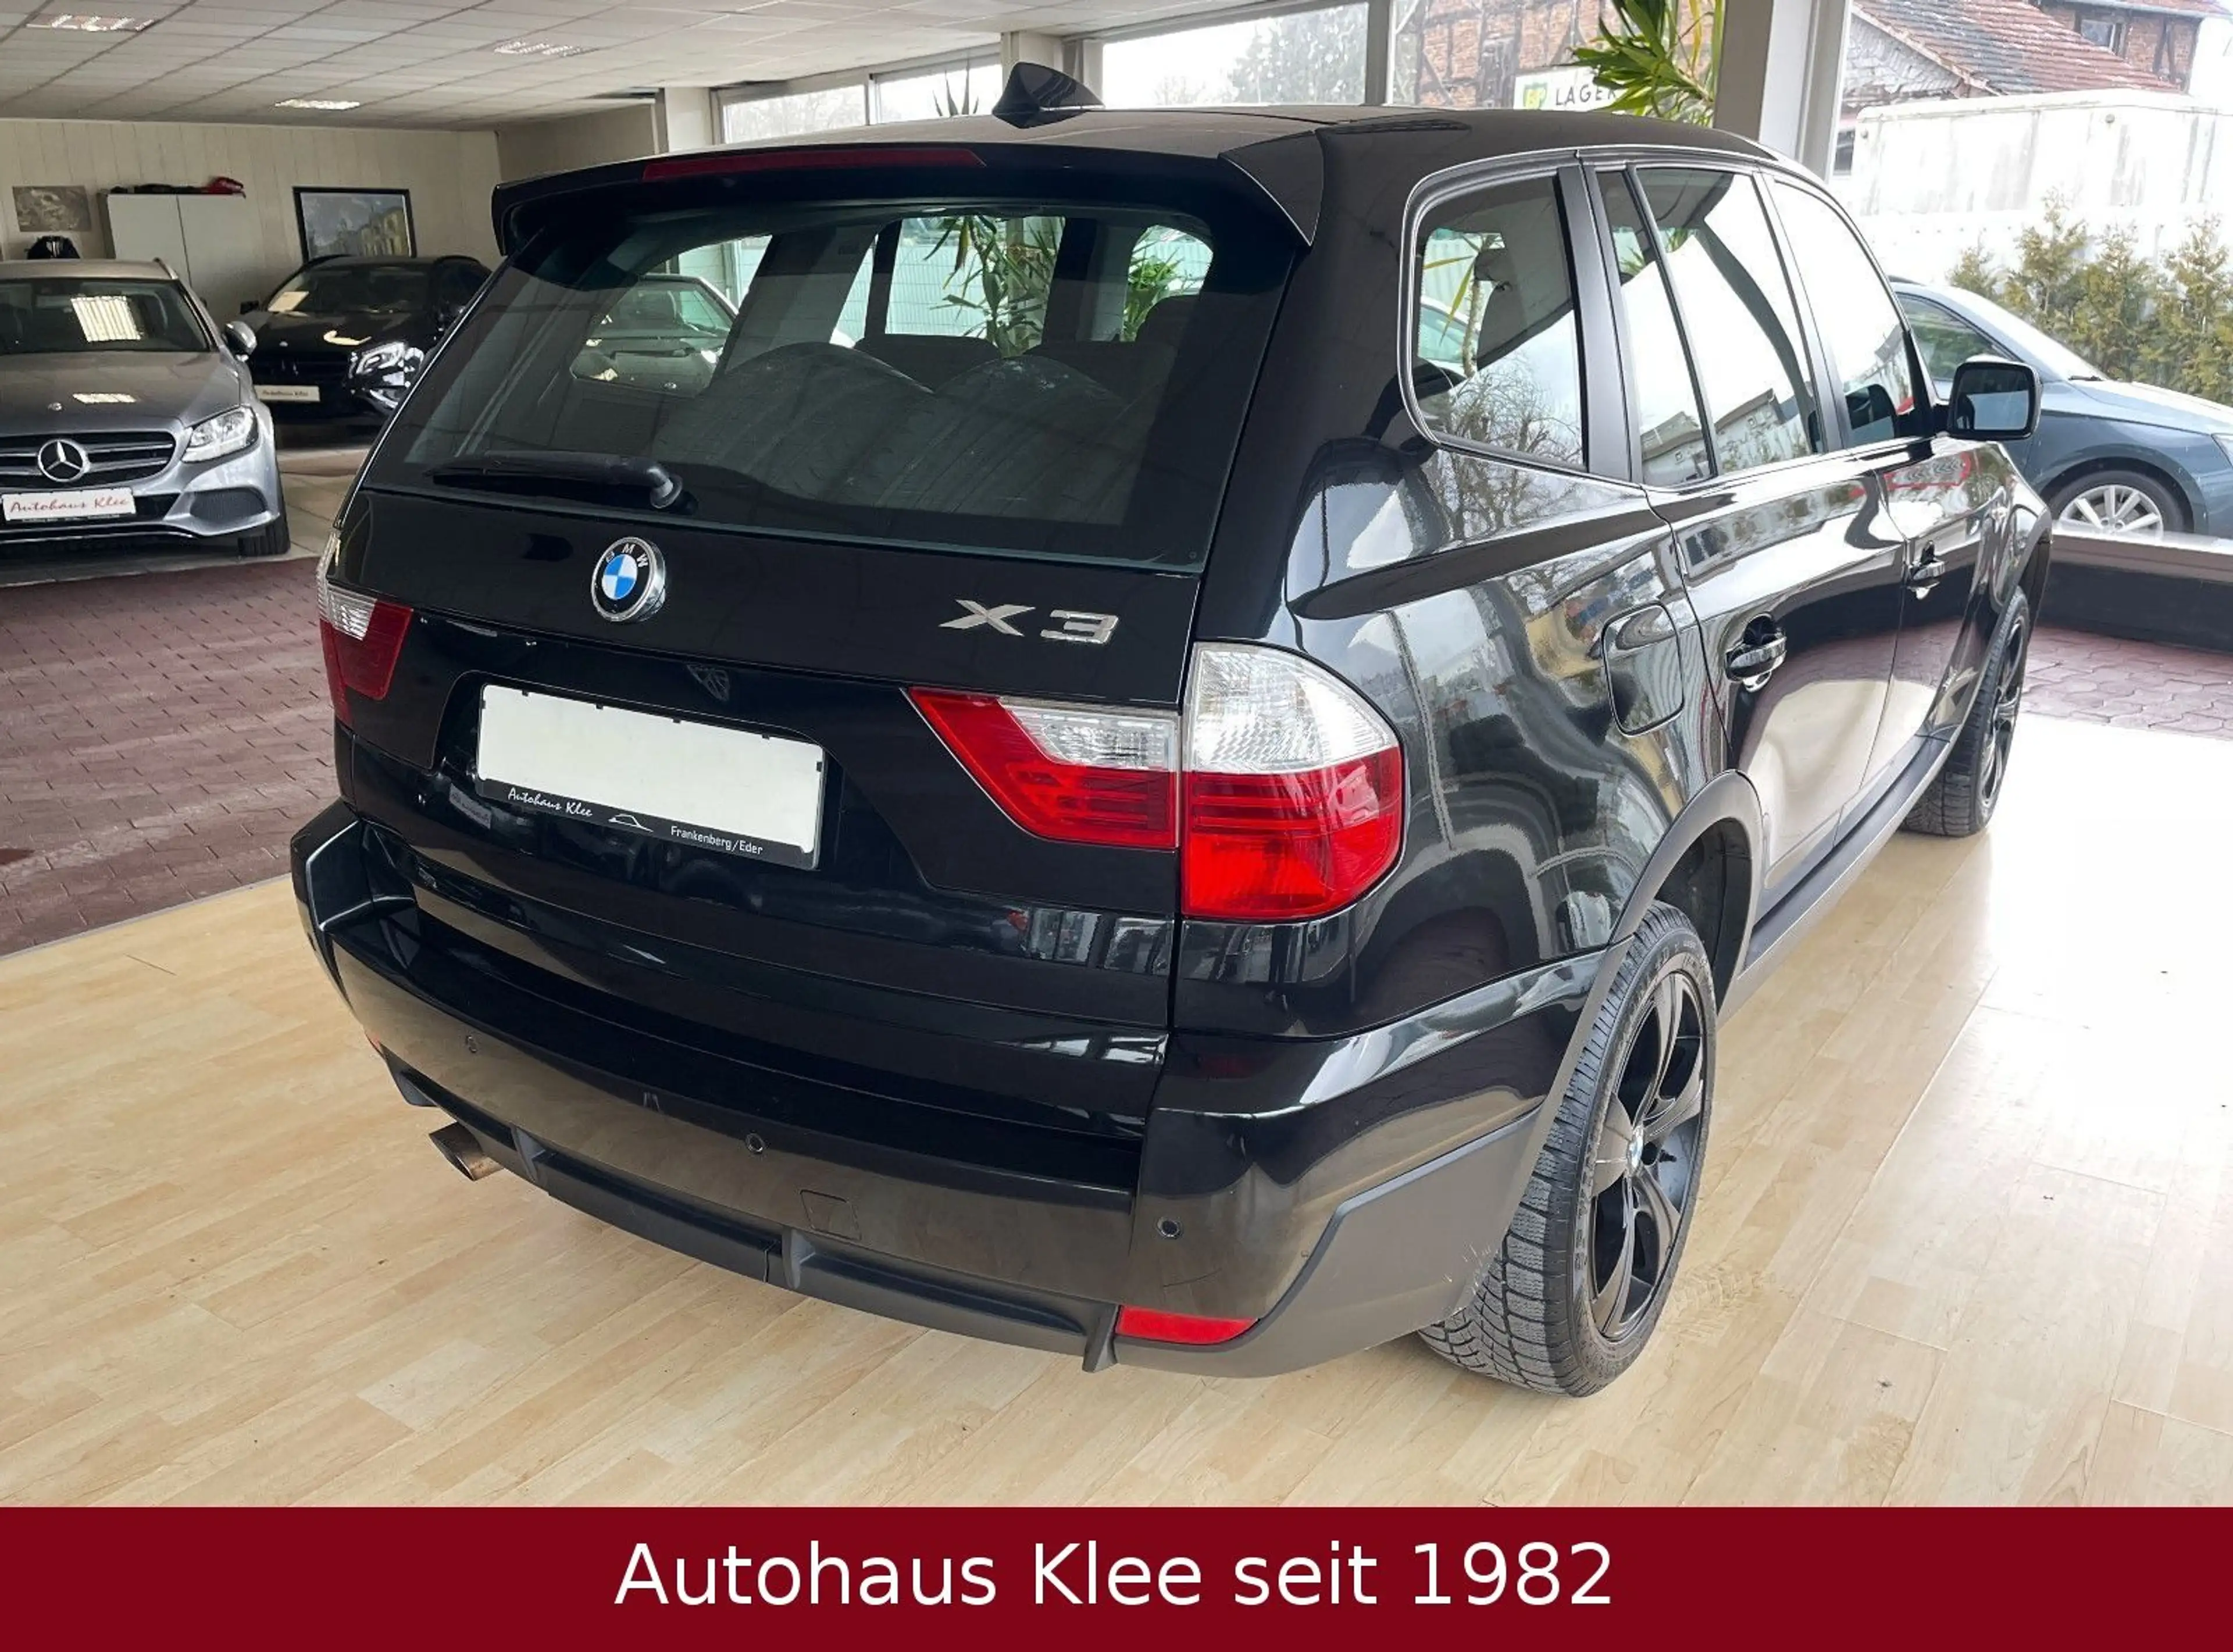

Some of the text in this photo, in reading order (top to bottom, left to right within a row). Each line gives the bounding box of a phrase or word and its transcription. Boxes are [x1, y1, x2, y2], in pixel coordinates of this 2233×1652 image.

[10, 496, 127, 513] Autohaus Klee
[605, 543, 649, 568] BMW
[508, 787, 562, 811] Autohaus
[565, 801, 593, 817] Klee
[670, 825, 764, 855] Frankenberg/Eder
